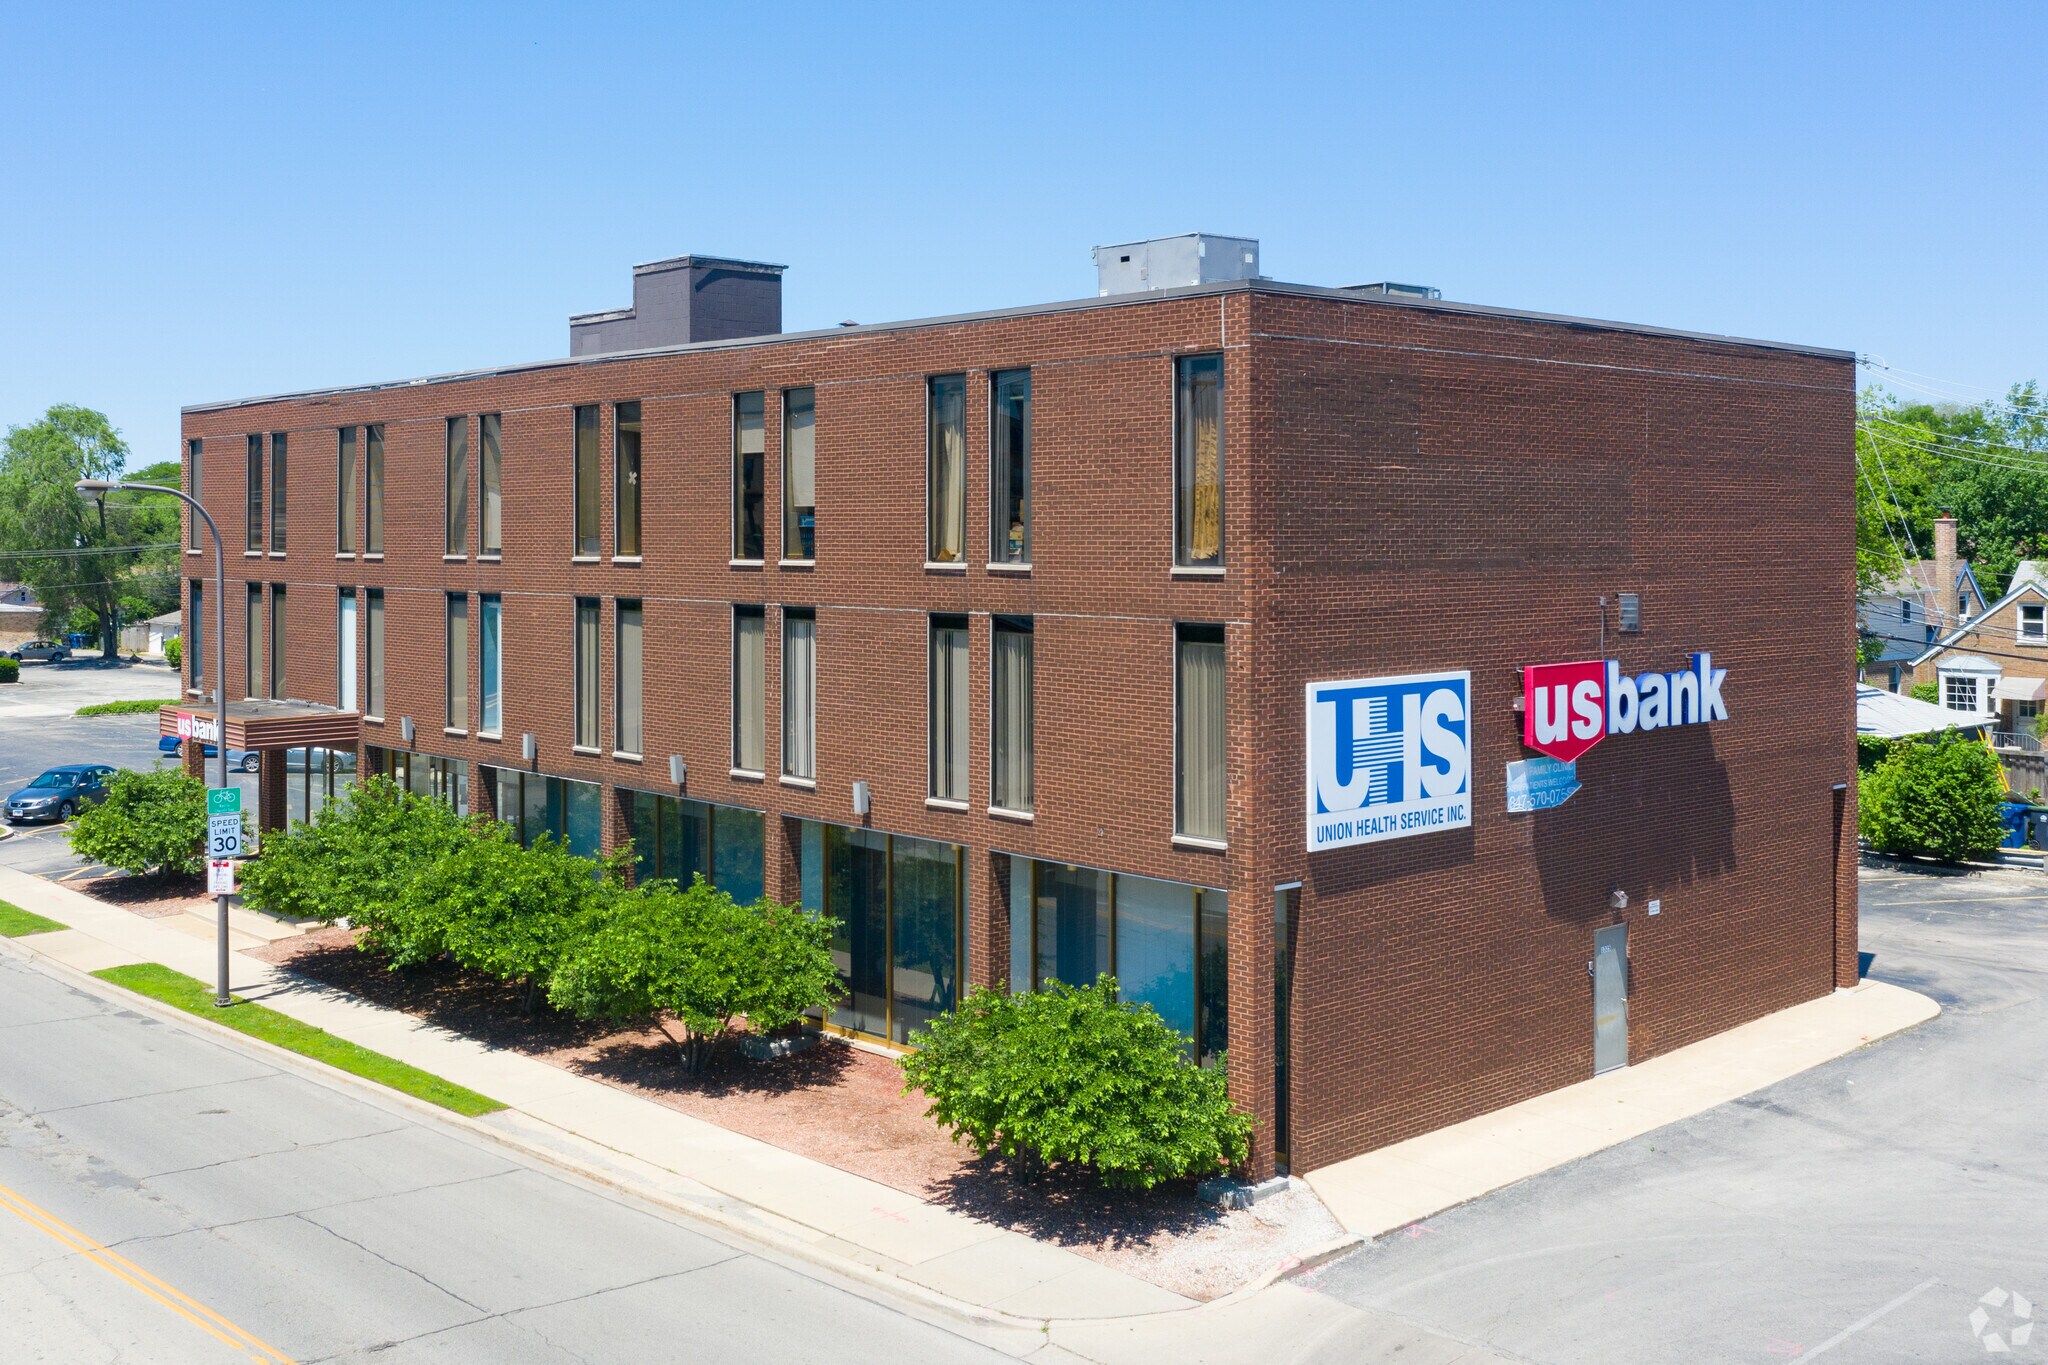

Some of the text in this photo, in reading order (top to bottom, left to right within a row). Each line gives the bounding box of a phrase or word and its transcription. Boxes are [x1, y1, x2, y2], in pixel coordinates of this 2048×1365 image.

[1315, 687, 1467, 813] UHS
[1529, 764, 1552, 776] FAMILY
[211, 818, 238, 828] SPEED
[1317, 804, 1466, 843] UNION HEALTH SERVICE INC.
[214, 827, 235, 836] LIMIT
[213, 836, 237, 852] 30
